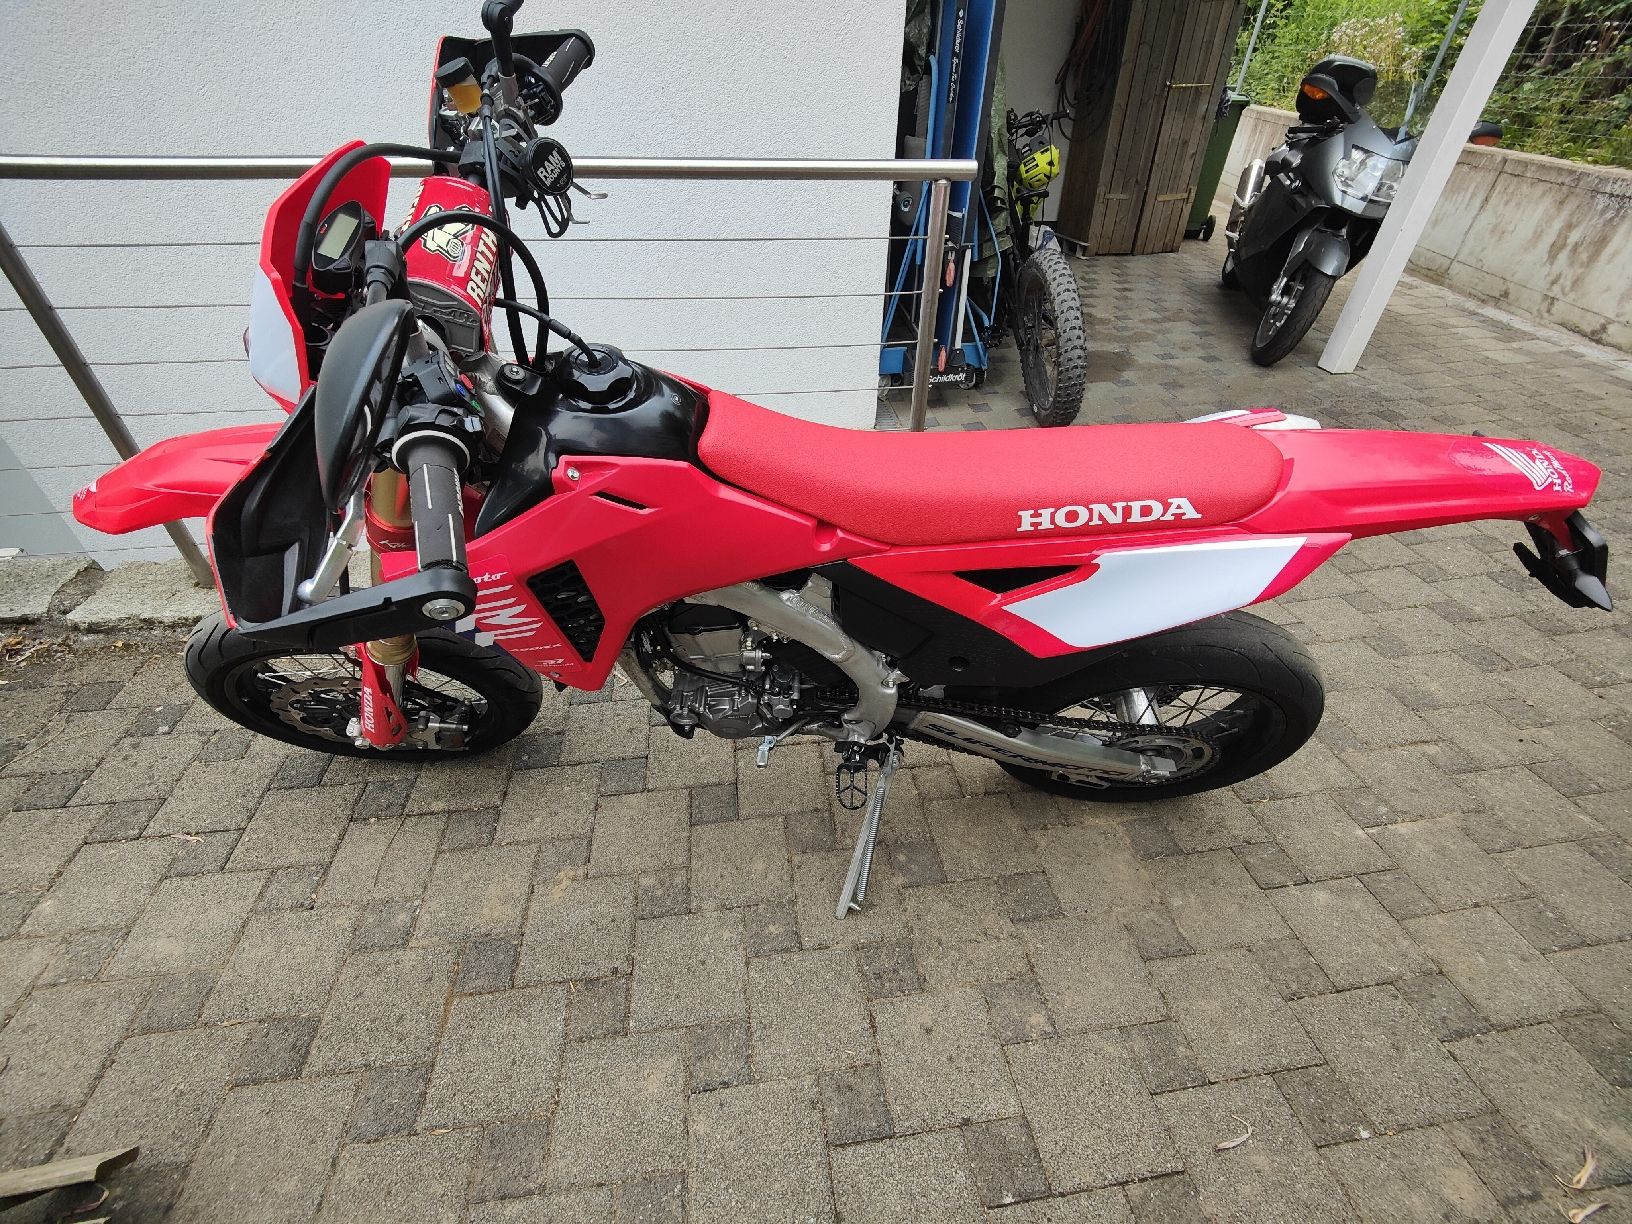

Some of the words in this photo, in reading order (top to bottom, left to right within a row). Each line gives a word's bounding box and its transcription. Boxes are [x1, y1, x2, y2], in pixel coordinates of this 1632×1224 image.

[537, 149, 561, 183] RAM
[545, 160, 566, 187] MOUNTS
[467, 226, 498, 308] RENTH
[1017, 498, 1202, 532] HONDA
[364, 686, 375, 733] HONDA
